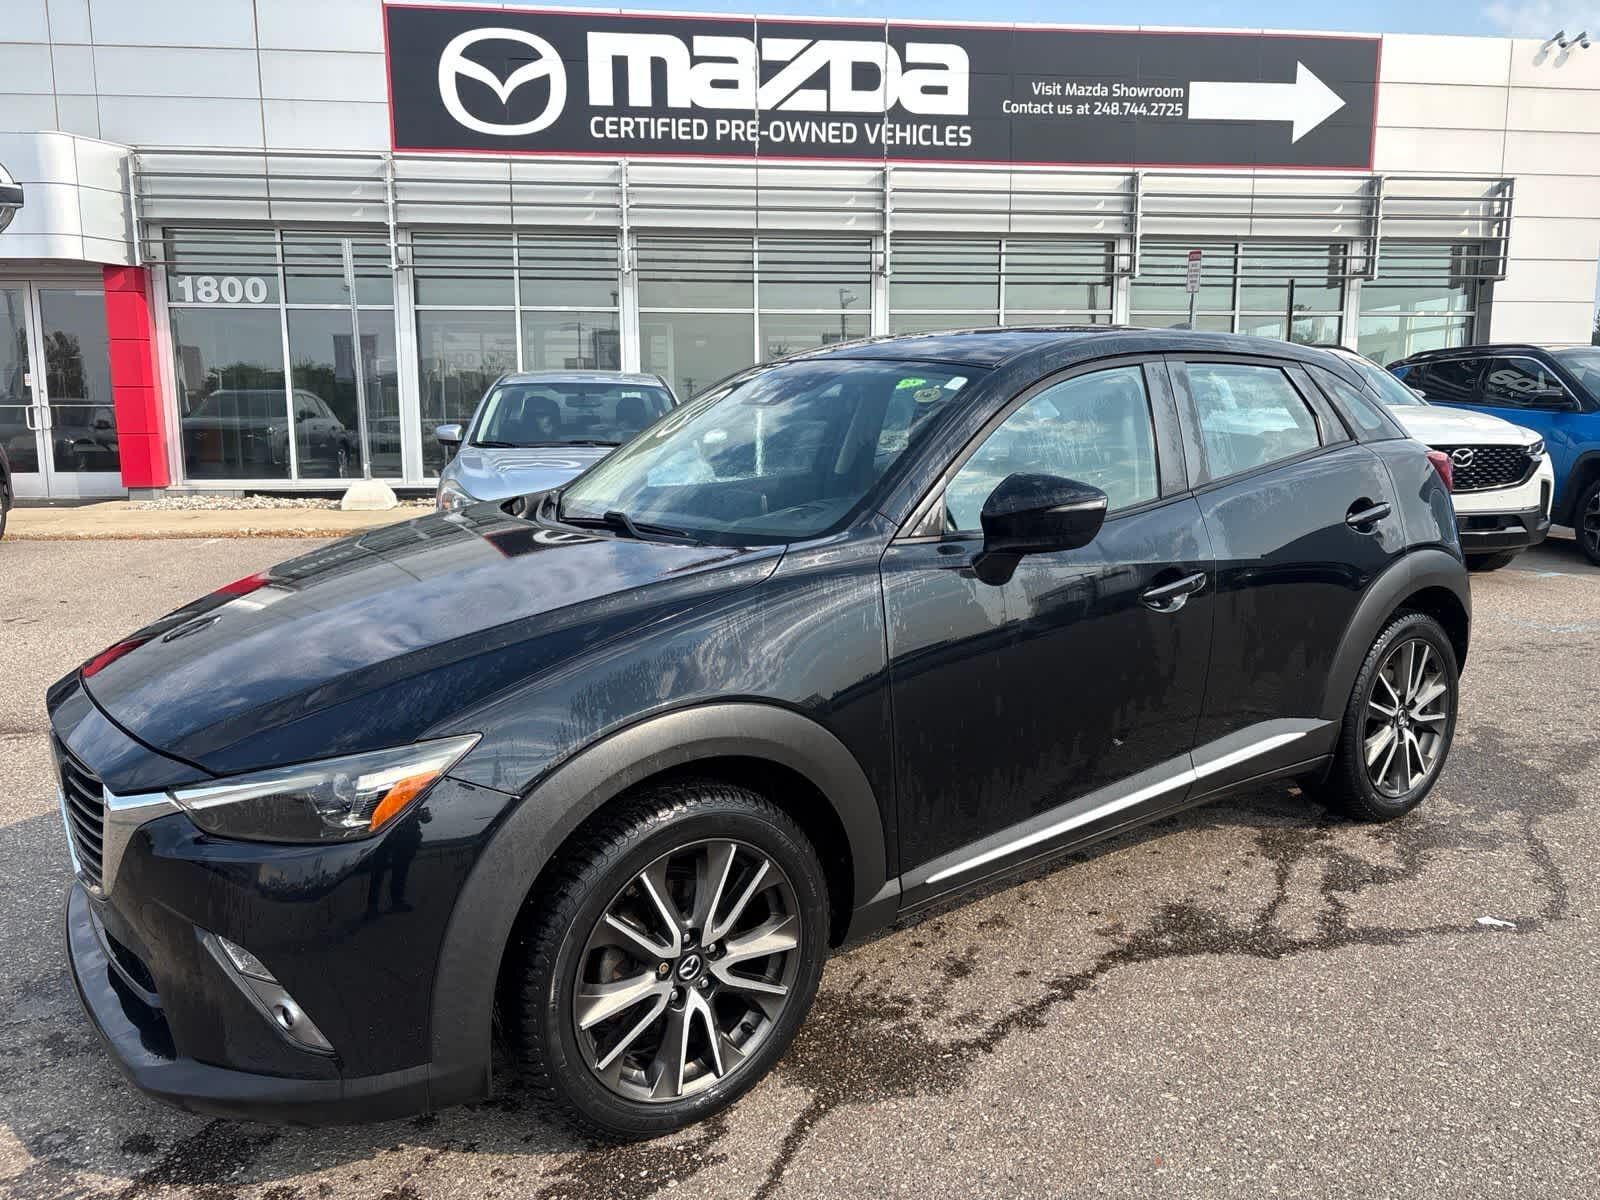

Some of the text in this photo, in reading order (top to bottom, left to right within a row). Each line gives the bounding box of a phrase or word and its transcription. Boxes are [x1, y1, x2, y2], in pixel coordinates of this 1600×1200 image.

[1032, 82, 1184, 99] Visit Mazda Showroom
[1002, 99, 1184, 118] Contact us at 248.744.2725
[590, 116, 973, 148] CERTIFIED PRE-OWNED VEHICLES
[177, 275, 268, 304] 1800
